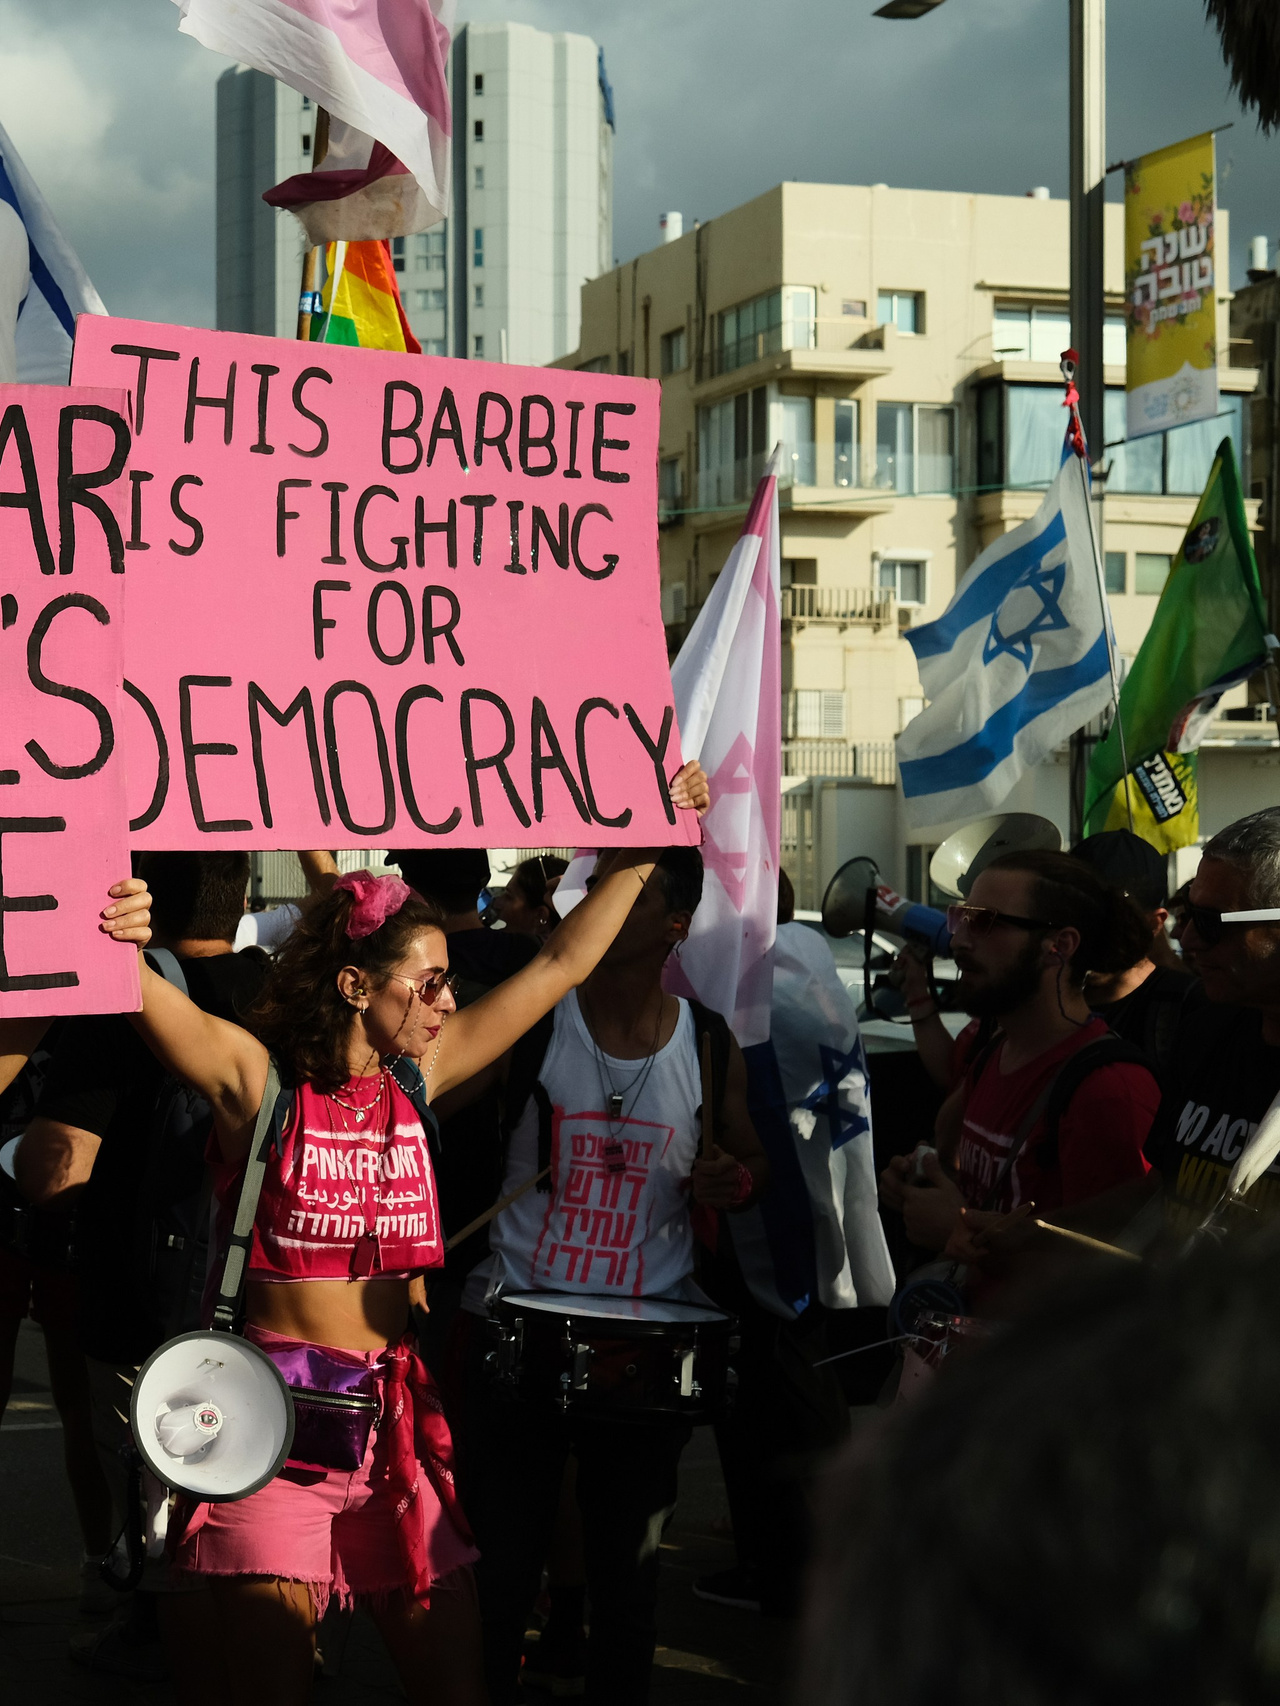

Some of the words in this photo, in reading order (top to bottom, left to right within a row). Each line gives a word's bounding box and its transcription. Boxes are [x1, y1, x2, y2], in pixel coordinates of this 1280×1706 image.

[1140, 225, 1207, 271] שנה
[1134, 256, 1212, 306] טובה
[111, 344, 332, 458] THIS
[381, 380, 636, 483] BARBIE
[128, 470, 204, 556] IS
[276, 479, 619, 581] FIGHTING
[312, 580, 465, 667] FOR
[296, 1181, 367, 1211] الوردية
[373, 1183, 427, 1210] الجبهة
[564, 1167, 646, 1211] דורש
[287, 1209, 366, 1239] הורודה
[377, 1211, 428, 1239] החזית
[559, 1205, 637, 1249] עתיד
[544, 1243, 629, 1287] ורוד!
